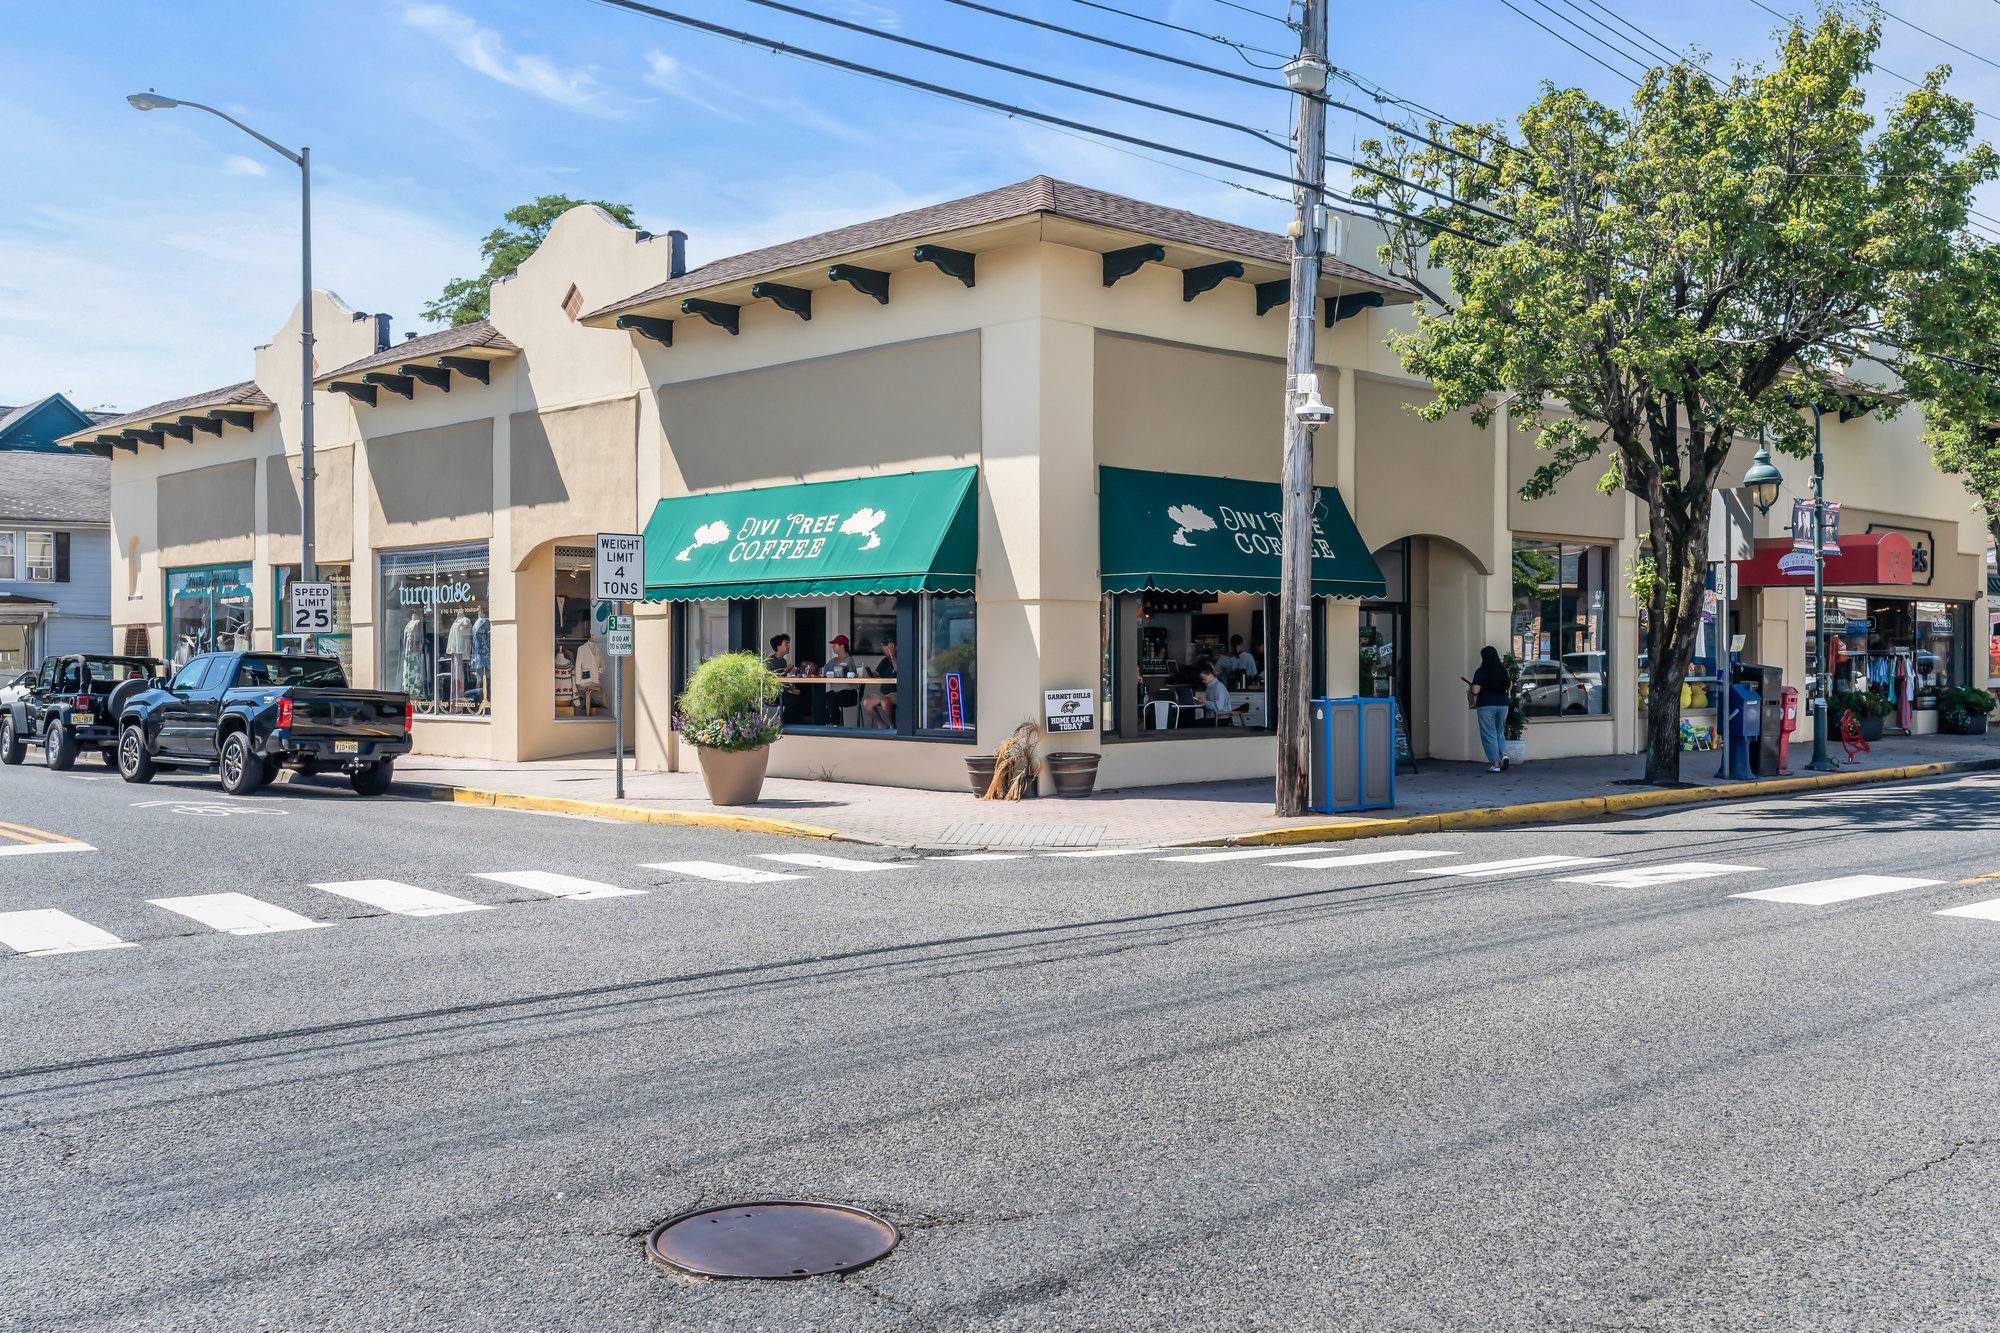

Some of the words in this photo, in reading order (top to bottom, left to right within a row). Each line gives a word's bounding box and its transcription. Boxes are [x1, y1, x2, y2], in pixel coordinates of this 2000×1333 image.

[737, 517, 781, 541] DIVI
[785, 513, 840, 537] TREE
[1219, 506, 1266, 531] DIVI
[1264, 511, 1325, 535] TE
[601, 538, 640, 551] WEIGHT
[728, 537, 827, 562] COFFEE
[1235, 532, 1336, 559] COFE
[607, 552, 634, 562] LIMIT
[614, 566, 625, 578] 4
[294, 588, 329, 597] SPEED
[603, 582, 638, 595] TONS
[298, 599, 326, 607] LIMIT
[295, 609, 329, 628] 25
[610, 616, 616, 629] 3
[948, 676, 962, 731] OPEN
[1070, 715, 1090, 723] GAME
